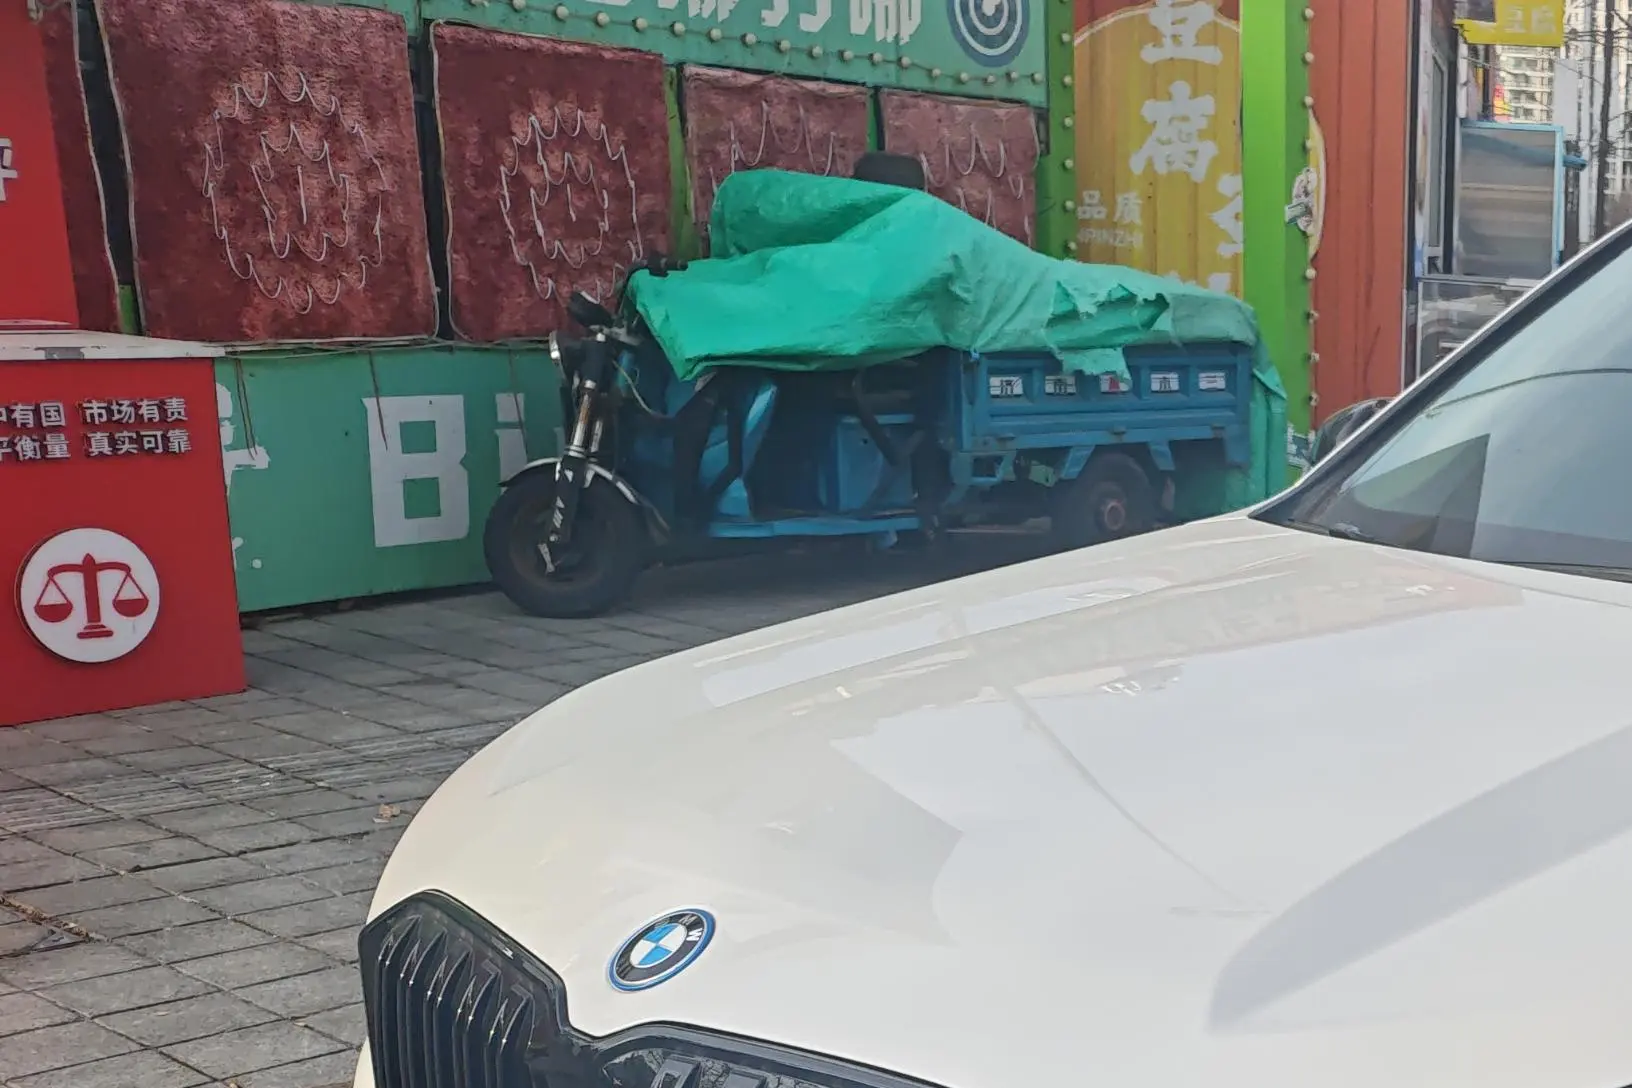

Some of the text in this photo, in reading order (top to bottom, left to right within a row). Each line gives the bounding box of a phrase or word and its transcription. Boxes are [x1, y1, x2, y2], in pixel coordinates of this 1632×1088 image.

[1077, 189, 1144, 226] 品质
[83, 397, 188, 425] 市场有责
[88, 429, 192, 457] 真实可靠
[360, 392, 565, 548] Bi
